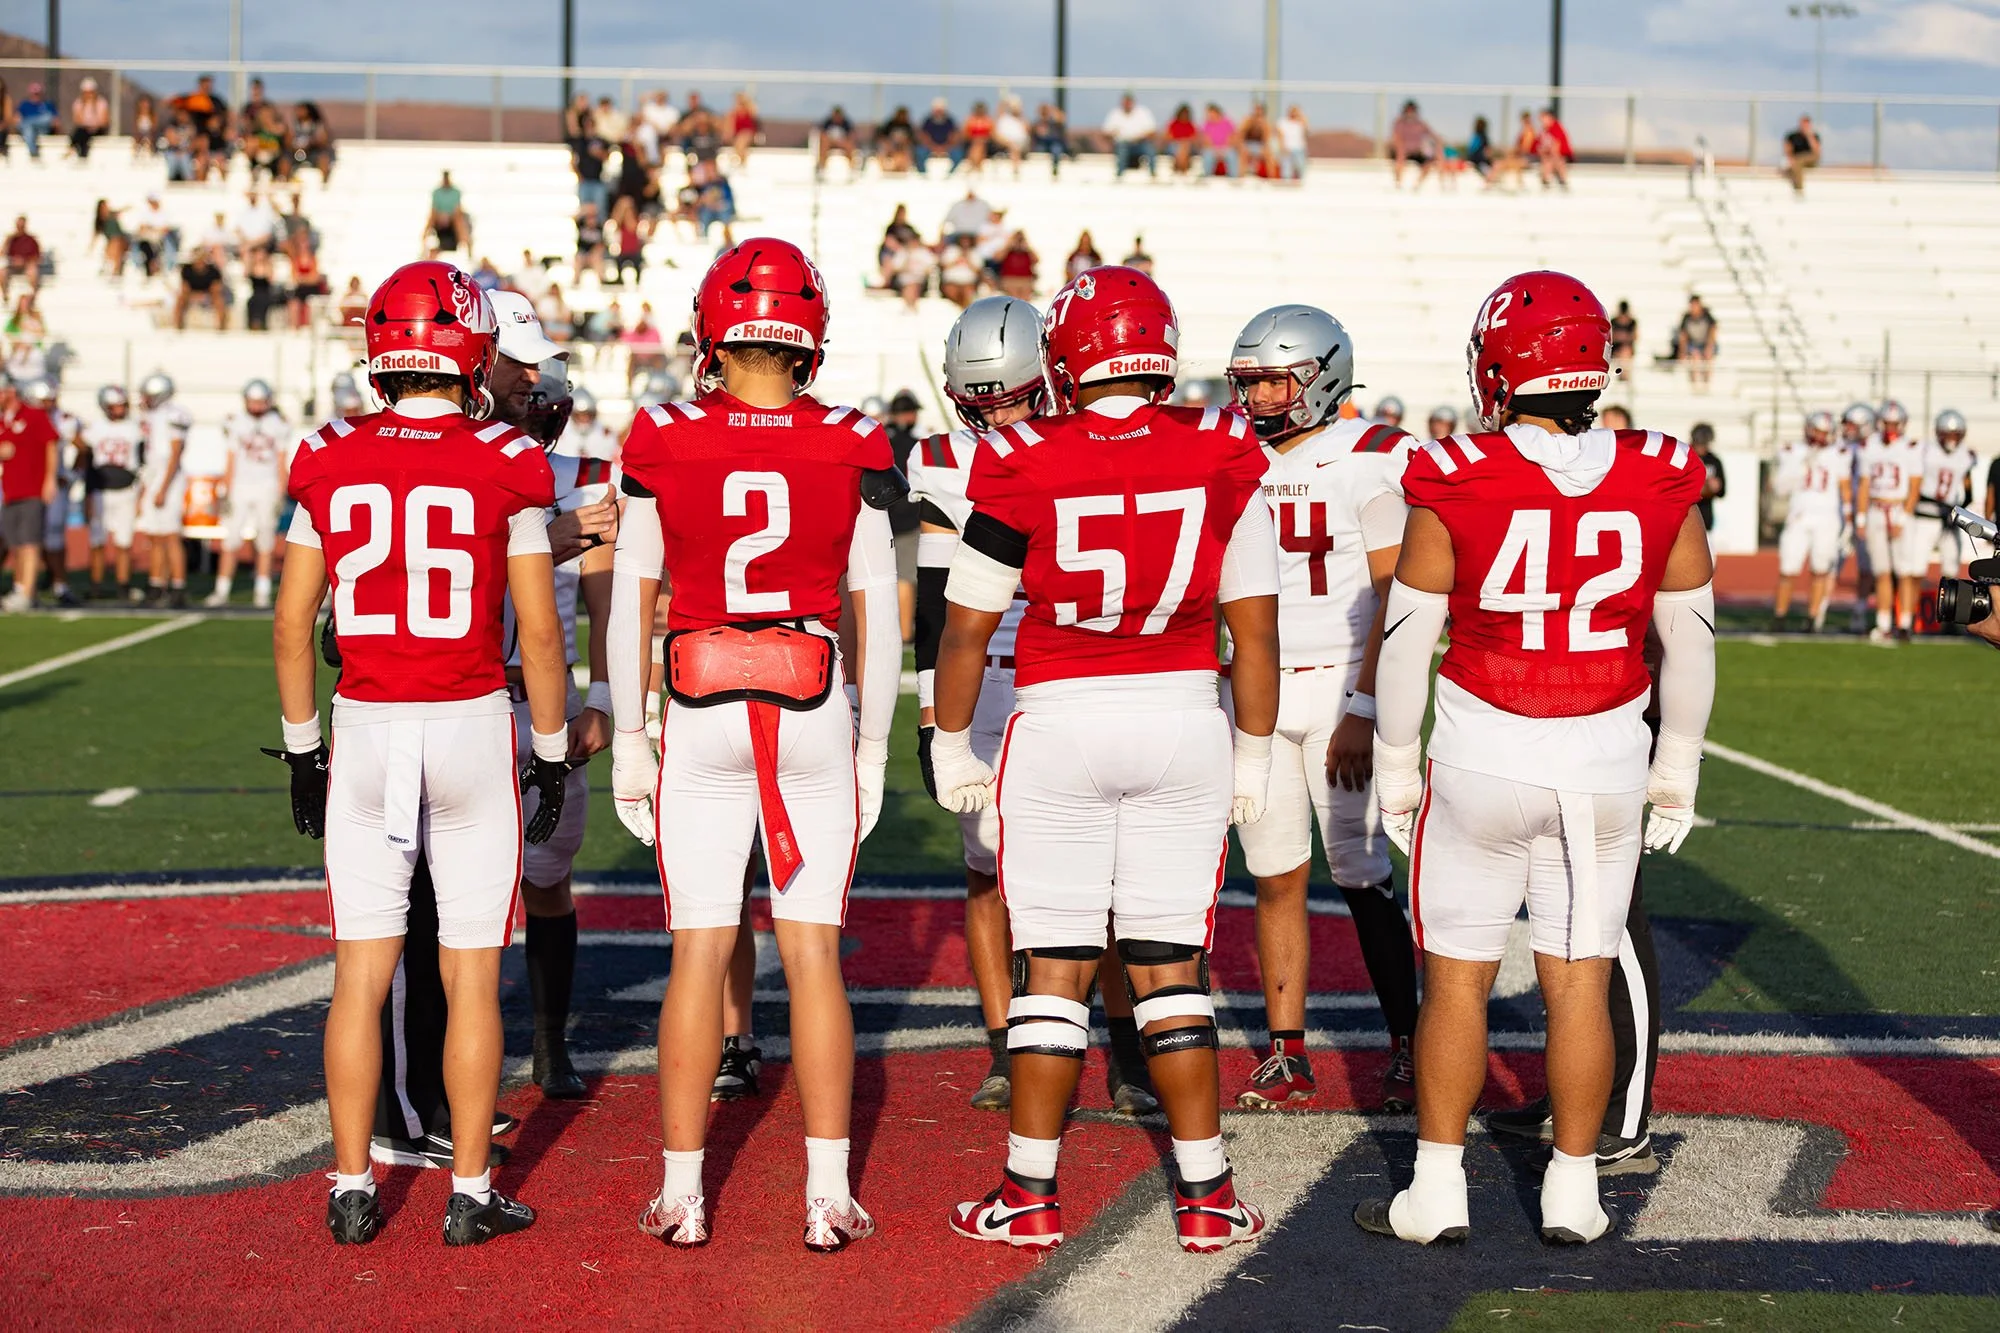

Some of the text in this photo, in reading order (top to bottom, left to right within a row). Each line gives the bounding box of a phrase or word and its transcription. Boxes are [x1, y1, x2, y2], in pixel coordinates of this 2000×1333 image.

[1477, 291, 1512, 333] 42
[743, 324, 803, 343] Riddell
[381, 355, 440, 370] Riddell
[1109, 357, 1170, 375] Riddell
[977, 385, 988, 393] F7
[1548, 374, 1605, 389] Riddell
[728, 413, 793, 428] RED KINGDOM
[376, 427, 443, 440] RED KINGDOM
[1277, 484, 1309, 497] VALLEY
[723, 471, 791, 613] 2
[1266, 502, 1334, 596] 4
[329, 483, 475, 639] 26
[1053, 486, 1207, 635] 57
[1479, 509, 1643, 652] 42
[1157, 1034, 1197, 1047] DONJOY
